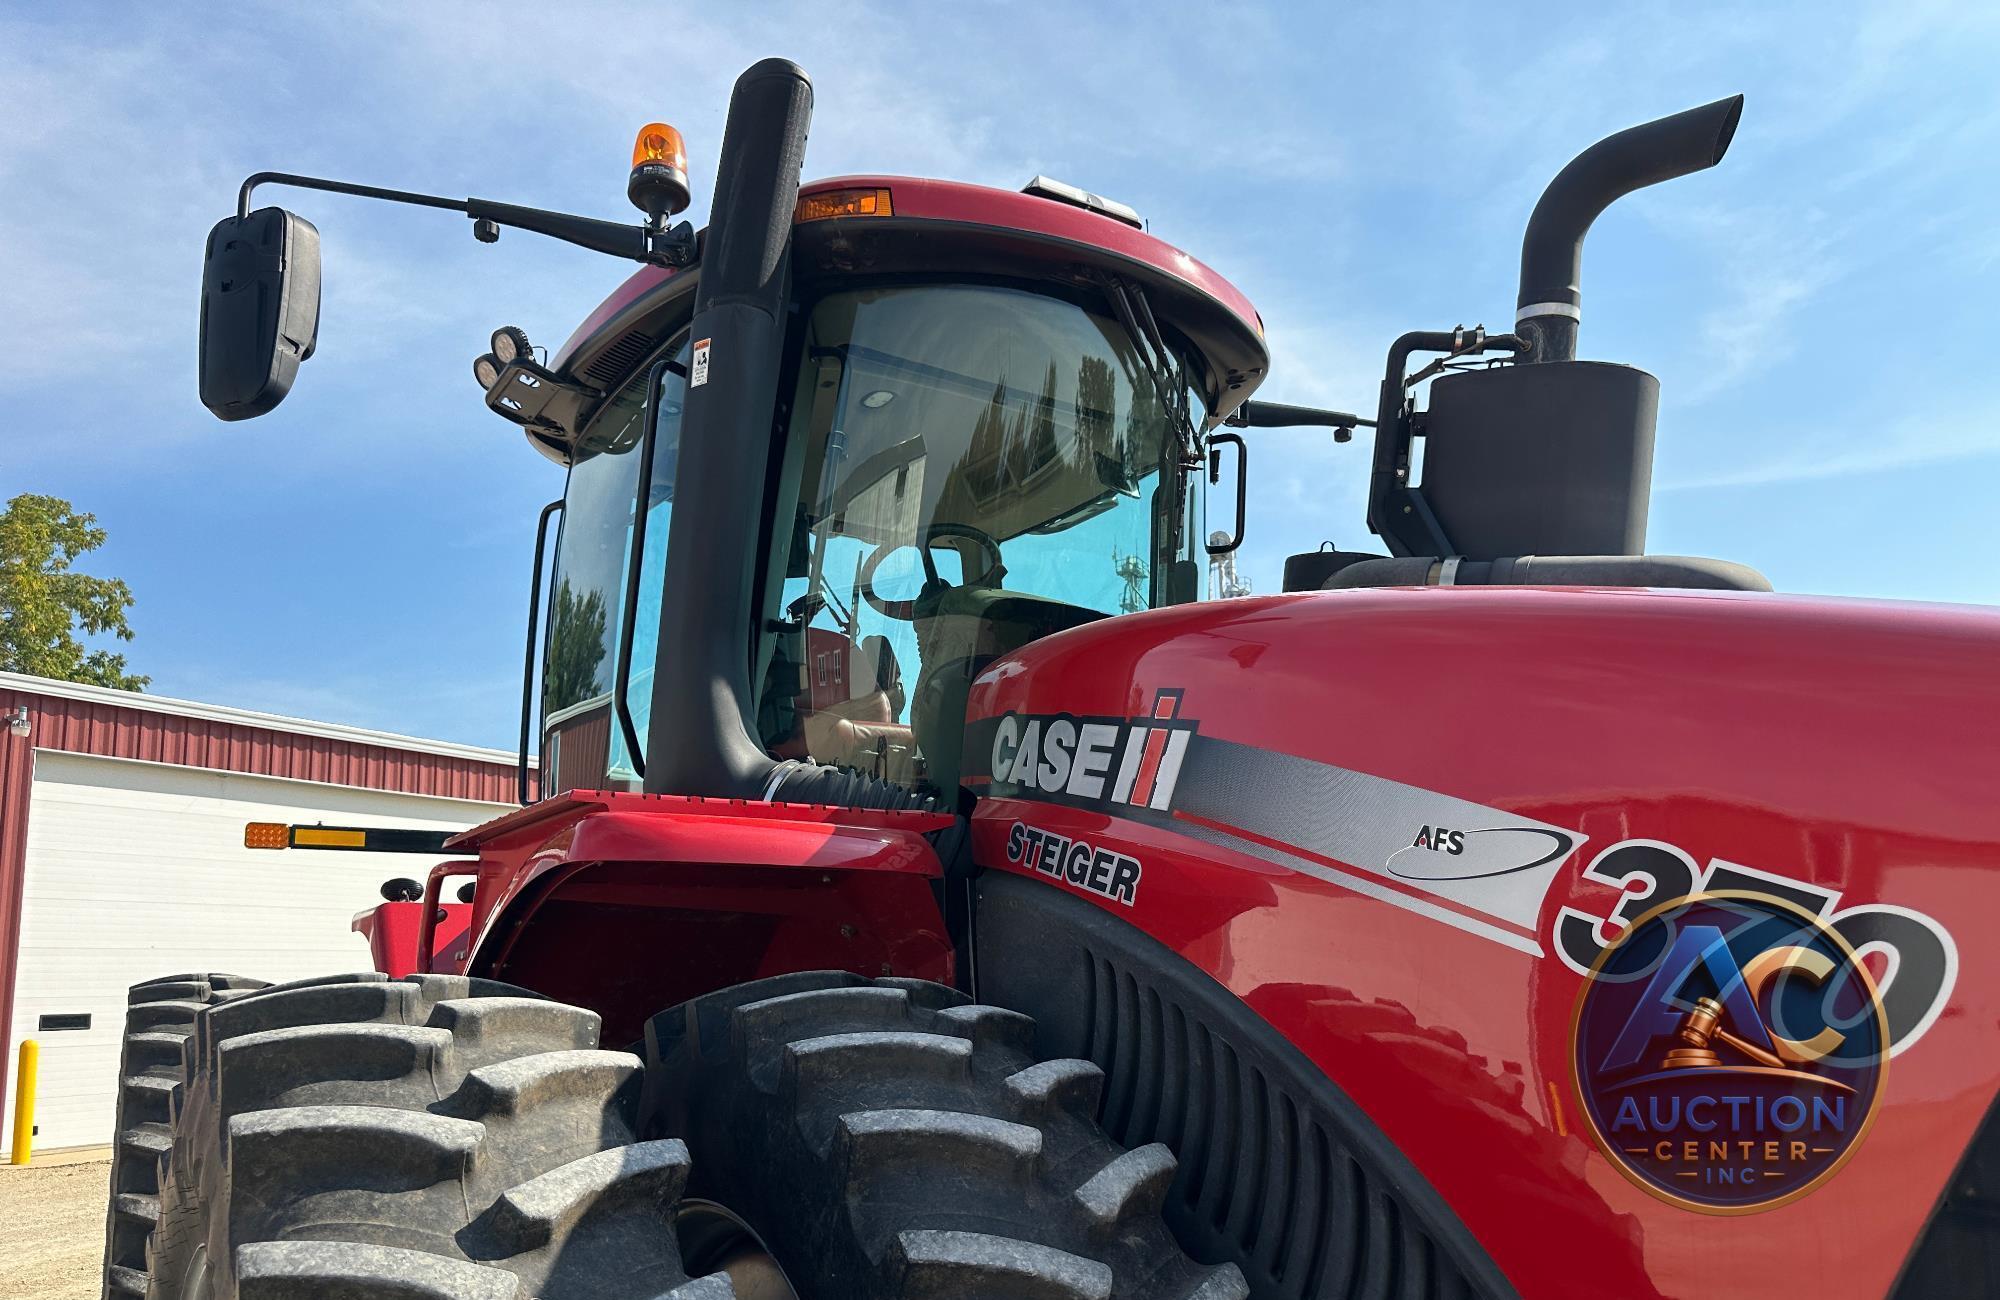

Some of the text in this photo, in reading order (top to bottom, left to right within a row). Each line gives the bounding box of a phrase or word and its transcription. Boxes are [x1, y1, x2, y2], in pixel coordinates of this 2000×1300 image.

[991, 715, 1119, 799] CASE
[1008, 822, 1142, 906] STEIGER
[1412, 823, 1465, 856] AFS
